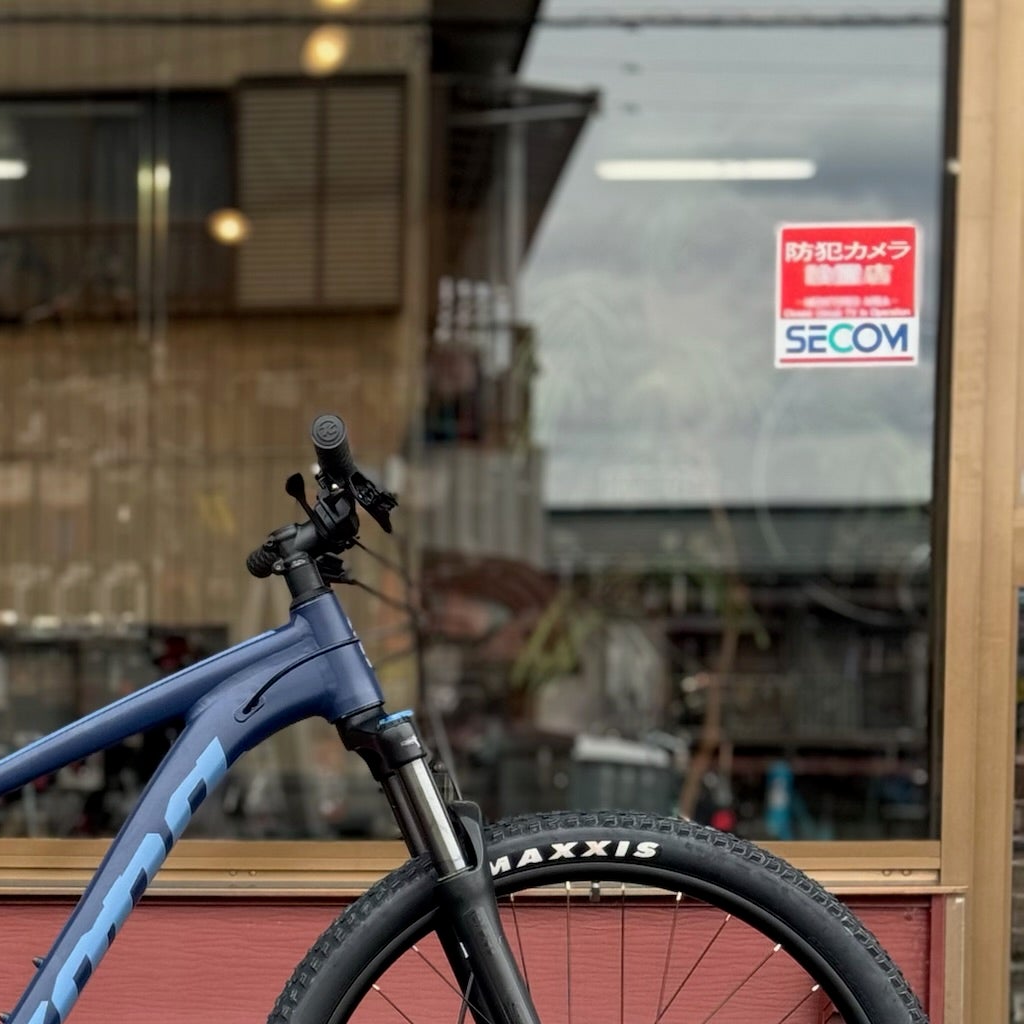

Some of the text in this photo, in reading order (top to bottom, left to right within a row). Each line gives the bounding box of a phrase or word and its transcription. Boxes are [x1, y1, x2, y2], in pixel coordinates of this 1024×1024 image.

[784, 240, 912, 263] 防犯カメラ
[785, 322, 908, 353] SECOM
[489, 840, 659, 876] MAXXIS
